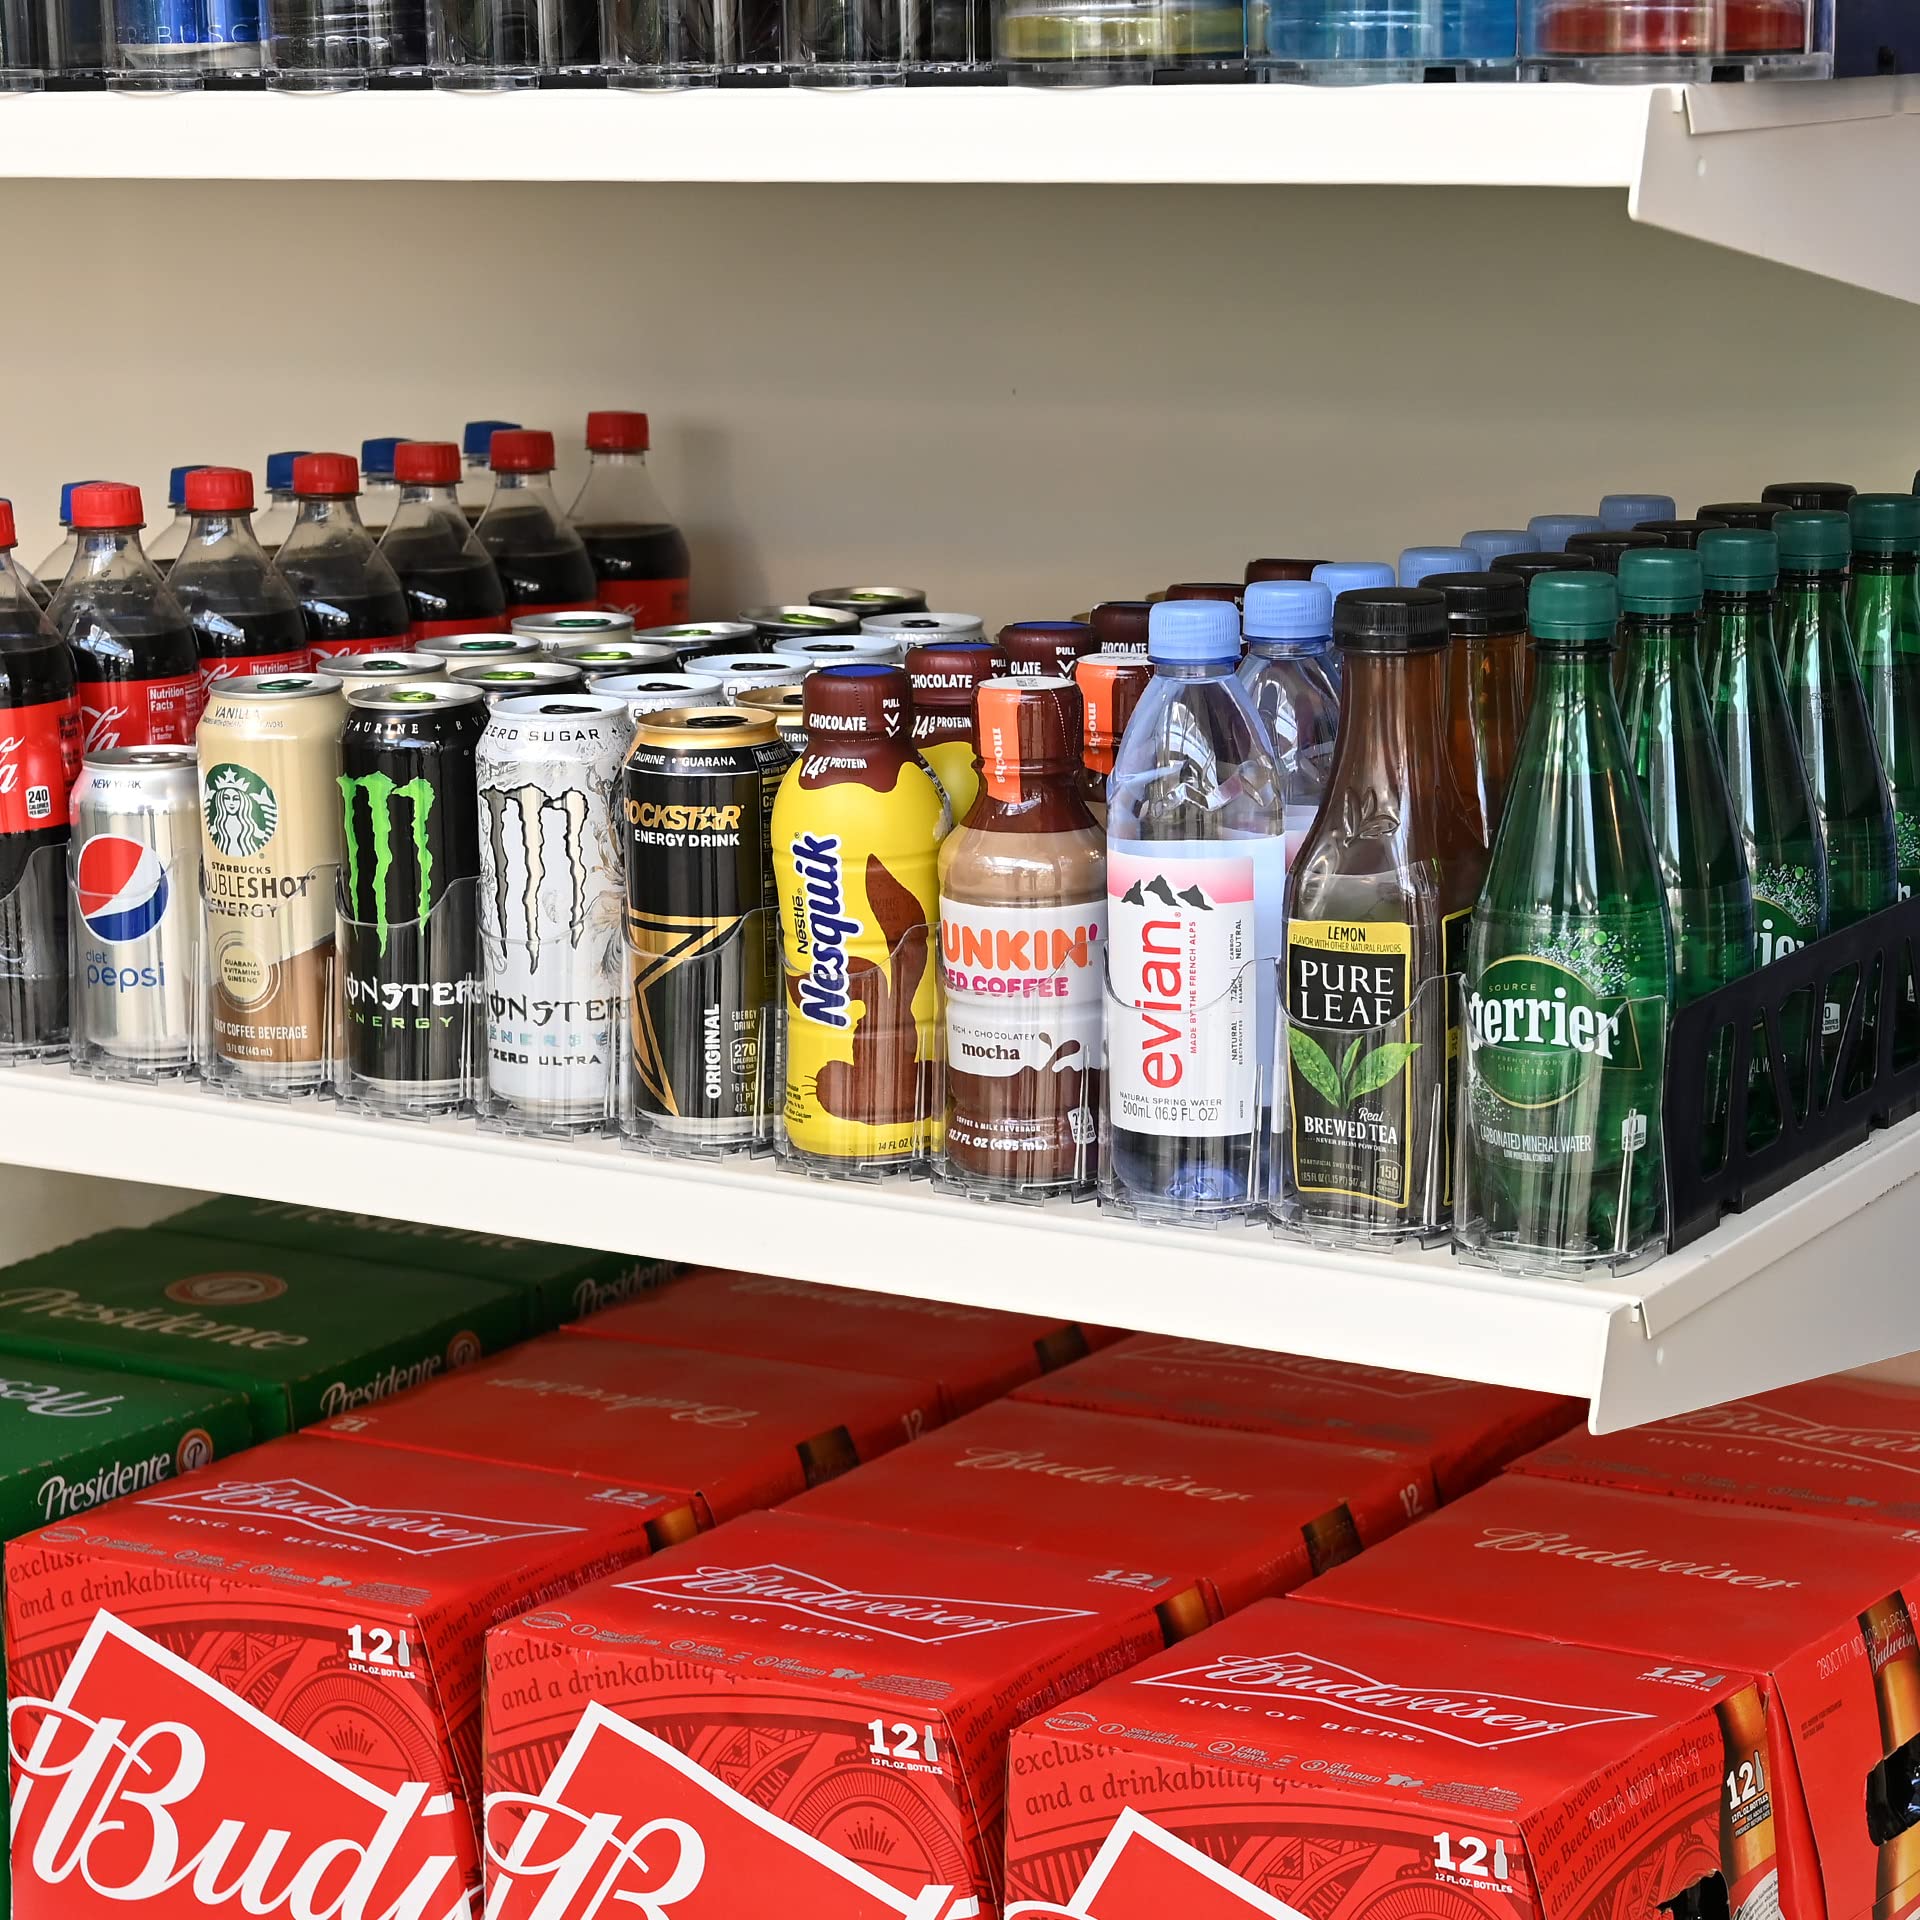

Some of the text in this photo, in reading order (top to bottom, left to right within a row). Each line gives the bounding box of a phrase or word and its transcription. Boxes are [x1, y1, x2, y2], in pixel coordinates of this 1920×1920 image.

[157, 24, 259, 45] BUSC
[1056, 647, 1075, 656] PULL
[150, 687, 184, 700] Nutrition
[883, 698, 900, 708] PULL
[150, 701, 174, 711] Facts
[347, 719, 419, 735] TAURINE
[809, 716, 866, 731] CHOCOLATE
[937, 716, 971, 729] PROTEIN
[485, 724, 600, 741] ZERO SUGAR
[634, 751, 736, 767] TAURINE GUARANA
[829, 757, 867, 769] PROTEIN
[992, 727, 1006, 783] mocha
[92, 779, 110, 789] NEW
[28, 789, 48, 803] 240
[624, 798, 740, 830] ROCKSTAR
[635, 829, 739, 847] ENERGY DRINK
[212, 862, 271, 874] STARBUCKS
[206, 870, 309, 899] OUBLESHOT
[210, 899, 277, 918] ENERGY
[793, 835, 859, 1027] Nesquik
[1328, 926, 1366, 942] LEMON
[942, 918, 1098, 970] UNKIN'
[1293, 934, 1401, 953] FLAVOR WITH OTHER NATURAL FLAVORS
[86, 950, 108, 964] diet
[1189, 949, 1197, 986] FRENCH
[87, 962, 166, 993] pepsi
[228, 976, 257, 985] GINSENG
[973, 975, 1069, 998] COFFEE
[1300, 960, 1394, 995] PURE
[1488, 983, 1537, 992] SOURCE
[1135, 919, 1183, 1089] evian
[1189, 990, 1197, 1009] THE
[1301, 990, 1392, 1025] LEAF
[732, 1010, 757, 1020] ENERGY
[1190, 1012, 1197, 1024] BY
[227, 1022, 308, 1039] COFFEE BEVERAGE
[735, 1021, 755, 1031] DRINK
[974, 1030, 1035, 1041] CHOCOLATEY
[493, 1050, 601, 1066] ZERO ULTRA
[704, 1003, 721, 1099] ORIGINAL
[735, 1043, 756, 1057] 270
[961, 1041, 1021, 1061] mocha
[1119, 1091, 1222, 1107] NATURAL SPRING WATER
[1122, 1100, 1218, 1122] 500mL (16.9 FL OZ)
[1358, 1107, 1384, 1121] Real
[980, 1123, 998, 1131] MILK
[1000, 1124, 1041, 1132] BEVERAGE
[1304, 1116, 1398, 1144] BREWED TEA
[961, 1134, 1048, 1151] FL OZ (405 mL)
[1316, 1137, 1386, 1153] NEVER FROM POWDER
[1480, 1124, 1592, 1153] CARBONATED MINERAL WATER
[1380, 1165, 1398, 1180] 150
[320, 1354, 440, 1416] Presidente
[902, 1409, 924, 1441] 12
[953, 1447, 1254, 1502] Budweiser
[38, 1453, 170, 1520] Presidente
[592, 1489, 649, 1502] 12
[1401, 1484, 1422, 1518] 12
[201, 1480, 500, 1543] Budweiser
[168, 1514, 227, 1528] KING
[238, 1525, 271, 1536] OF
[1474, 1527, 1801, 1591] Budweiser
[1094, 1569, 1154, 1585] 12
[20, 1588, 54, 1619] and
[61, 1589, 74, 1608] a
[682, 1566, 1008, 1631] Budweiser
[652, 1602, 718, 1616] KING
[731, 1614, 761, 1625] OF
[348, 1624, 394, 1666] 12
[380, 1668, 416, 1680] BOTTLES
[1643, 1667, 1706, 1682] 12
[502, 1678, 541, 1710] and
[548, 1680, 562, 1698] a
[1205, 1655, 1565, 1735] Budweiser
[1180, 1697, 1254, 1713] KING
[1266, 1709, 1305, 1722] OF
[868, 1719, 920, 1760] 12
[1121, 1731, 1199, 1750] BUDWEISER.COM
[1231, 1750, 1270, 1763] POINTS
[1238, 1745, 1268, 1757] EARN
[907, 1764, 943, 1775] BOTTLES
[1324, 1768, 1382, 1784] REWARDED
[1330, 1762, 1352, 1771] GET
[1727, 1760, 1756, 1810] 12
[1026, 1782, 1072, 1816] and
[1079, 1784, 1095, 1804] a
[1750, 1793, 1769, 1812] BOTTLES
[1538, 1774, 1600, 1857] other brewer
[1433, 1832, 1489, 1876] 12
[1551, 1815, 1639, 1916] drinkability you
[1435, 1873, 1513, 1894] 12 FL. OZ. BOTTLES
